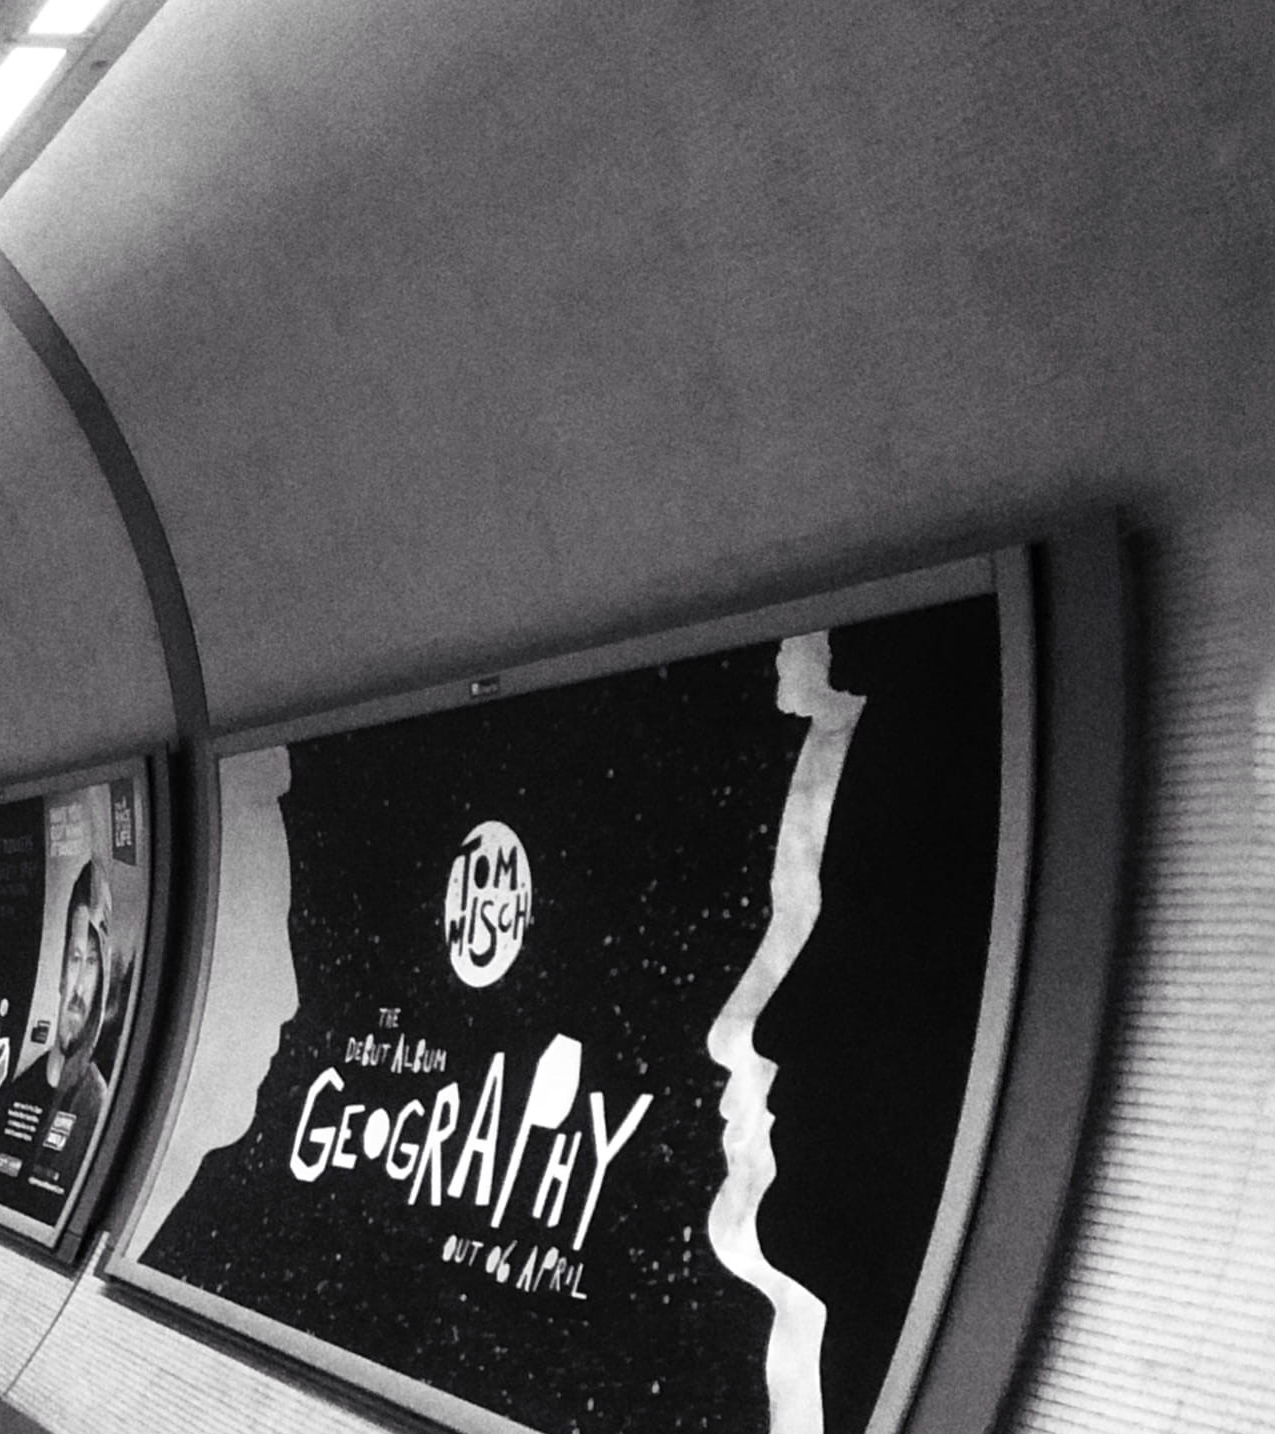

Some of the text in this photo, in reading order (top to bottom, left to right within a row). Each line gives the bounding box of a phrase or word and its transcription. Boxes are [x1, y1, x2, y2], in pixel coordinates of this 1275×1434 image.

[453, 834, 518, 912] TOM
[449, 891, 529, 968] MISCH
[344, 1032, 448, 1075] DEBUT ALBUM
[378, 1007, 402, 1029] THE
[289, 1032, 654, 1251] GEOGRAPHY
[441, 1234, 588, 1300] OUT 06 APRIL
